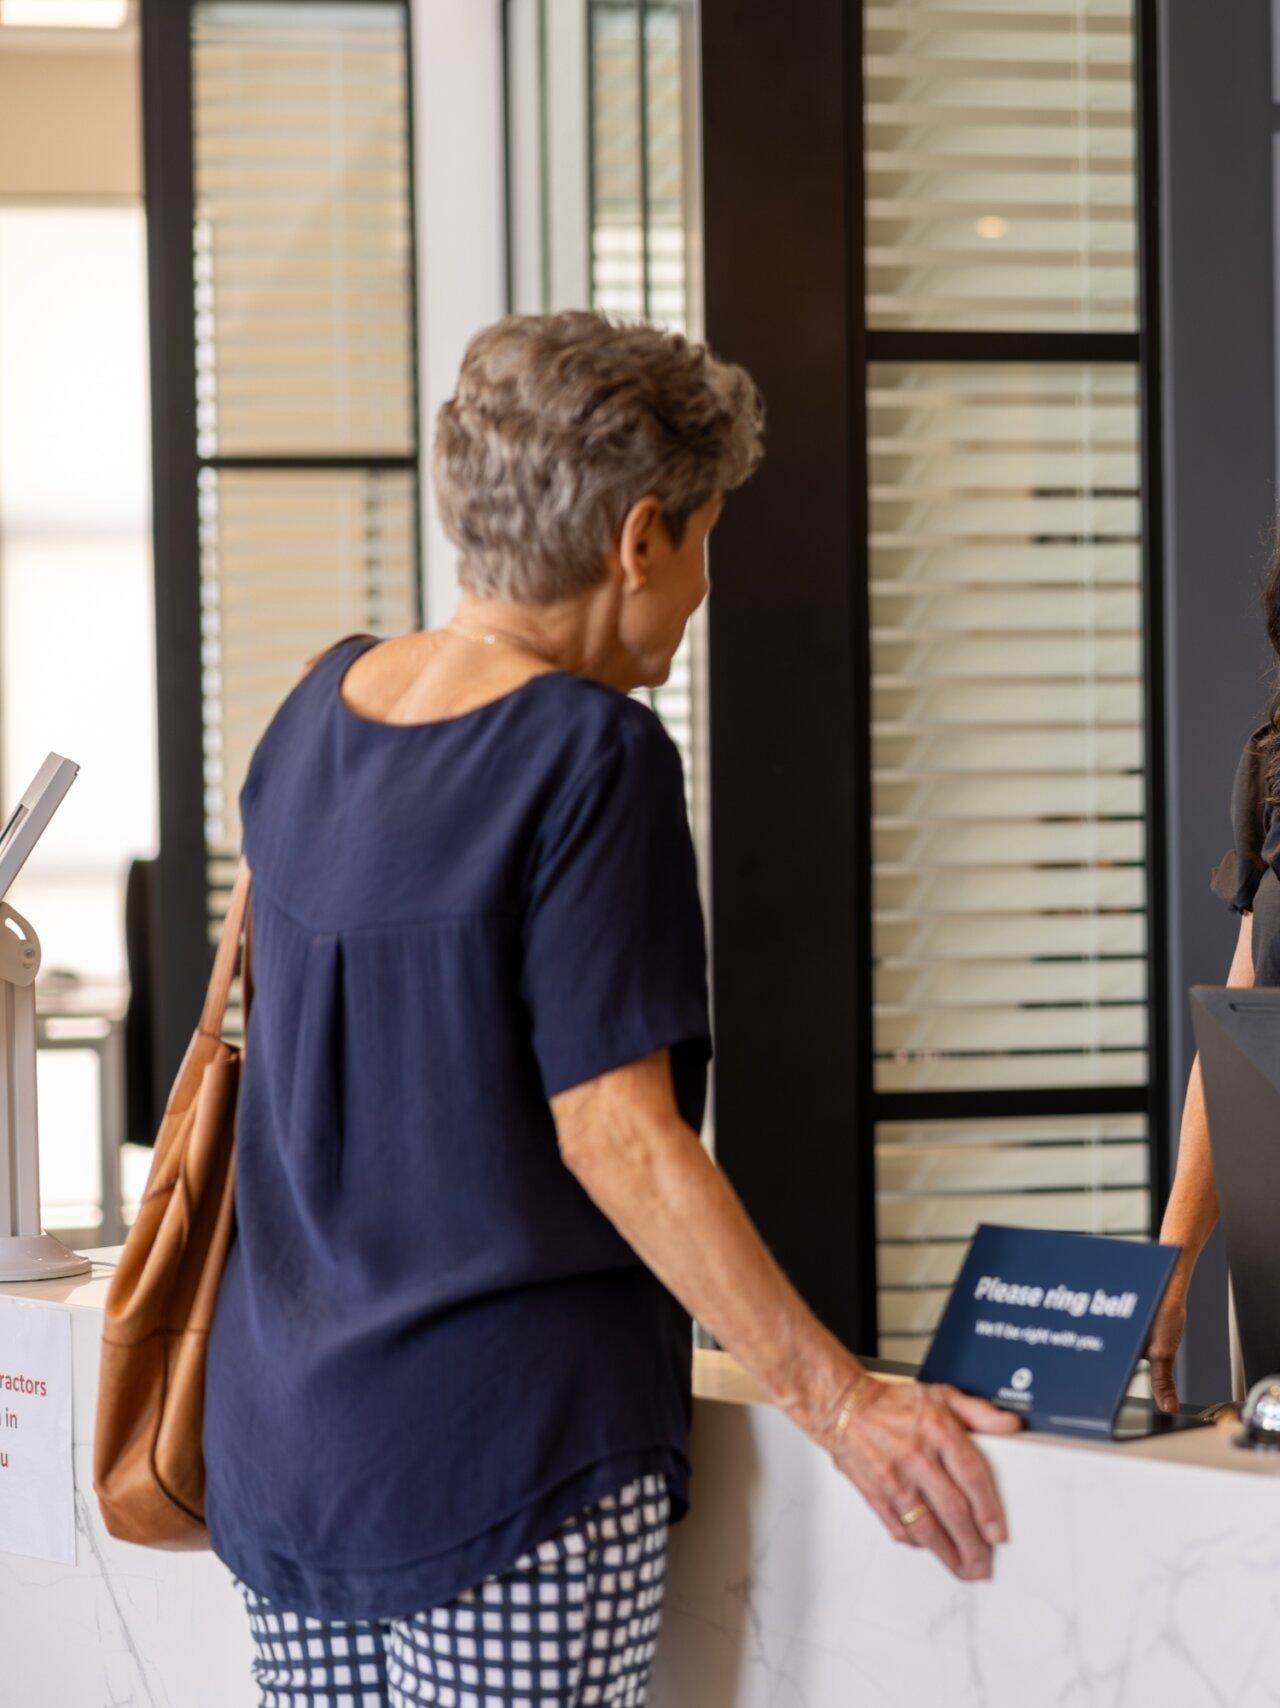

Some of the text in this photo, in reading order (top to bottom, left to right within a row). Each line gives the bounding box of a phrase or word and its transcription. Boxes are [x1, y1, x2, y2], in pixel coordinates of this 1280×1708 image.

[974, 1276, 1138, 1318] Please ring bell
[1003, 1321, 1020, 1341] be
[1020, 1323, 1050, 1345] right
[1050, 1327, 1076, 1348] with
[5, 1407, 18, 1429] in
